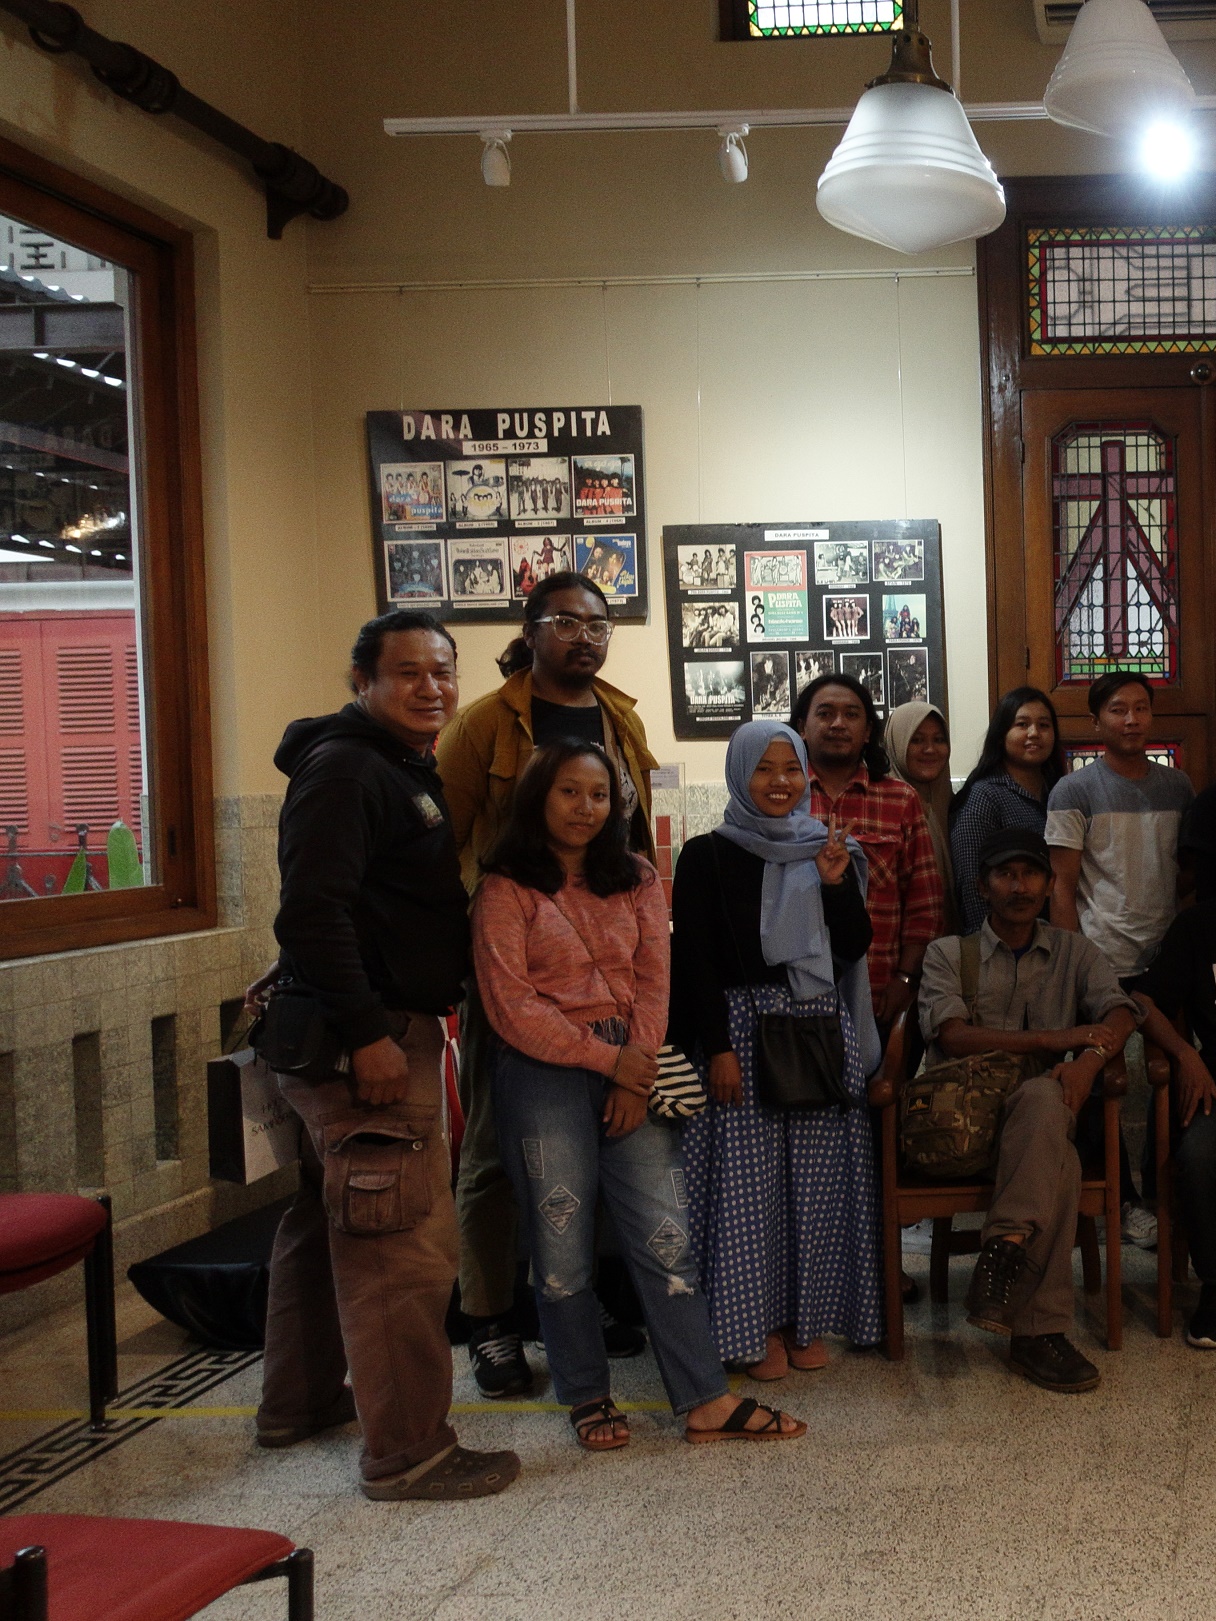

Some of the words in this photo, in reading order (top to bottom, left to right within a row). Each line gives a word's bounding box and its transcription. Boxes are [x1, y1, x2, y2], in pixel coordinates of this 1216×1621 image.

[403, 414, 472, 440] DARA
[497, 410, 612, 438] PUSPITA
[471, 442, 499, 453] 1965
[511, 441, 540, 452] 1973
[389, 494, 411, 503] dara
[576, 499, 598, 507] DARA
[599, 497, 632, 506] PUSPITA
[411, 505, 443, 516] puspita
[776, 592, 799, 600] DARA
[690, 696, 707, 704] DARA
[708, 694, 735, 704] PUSPITA
